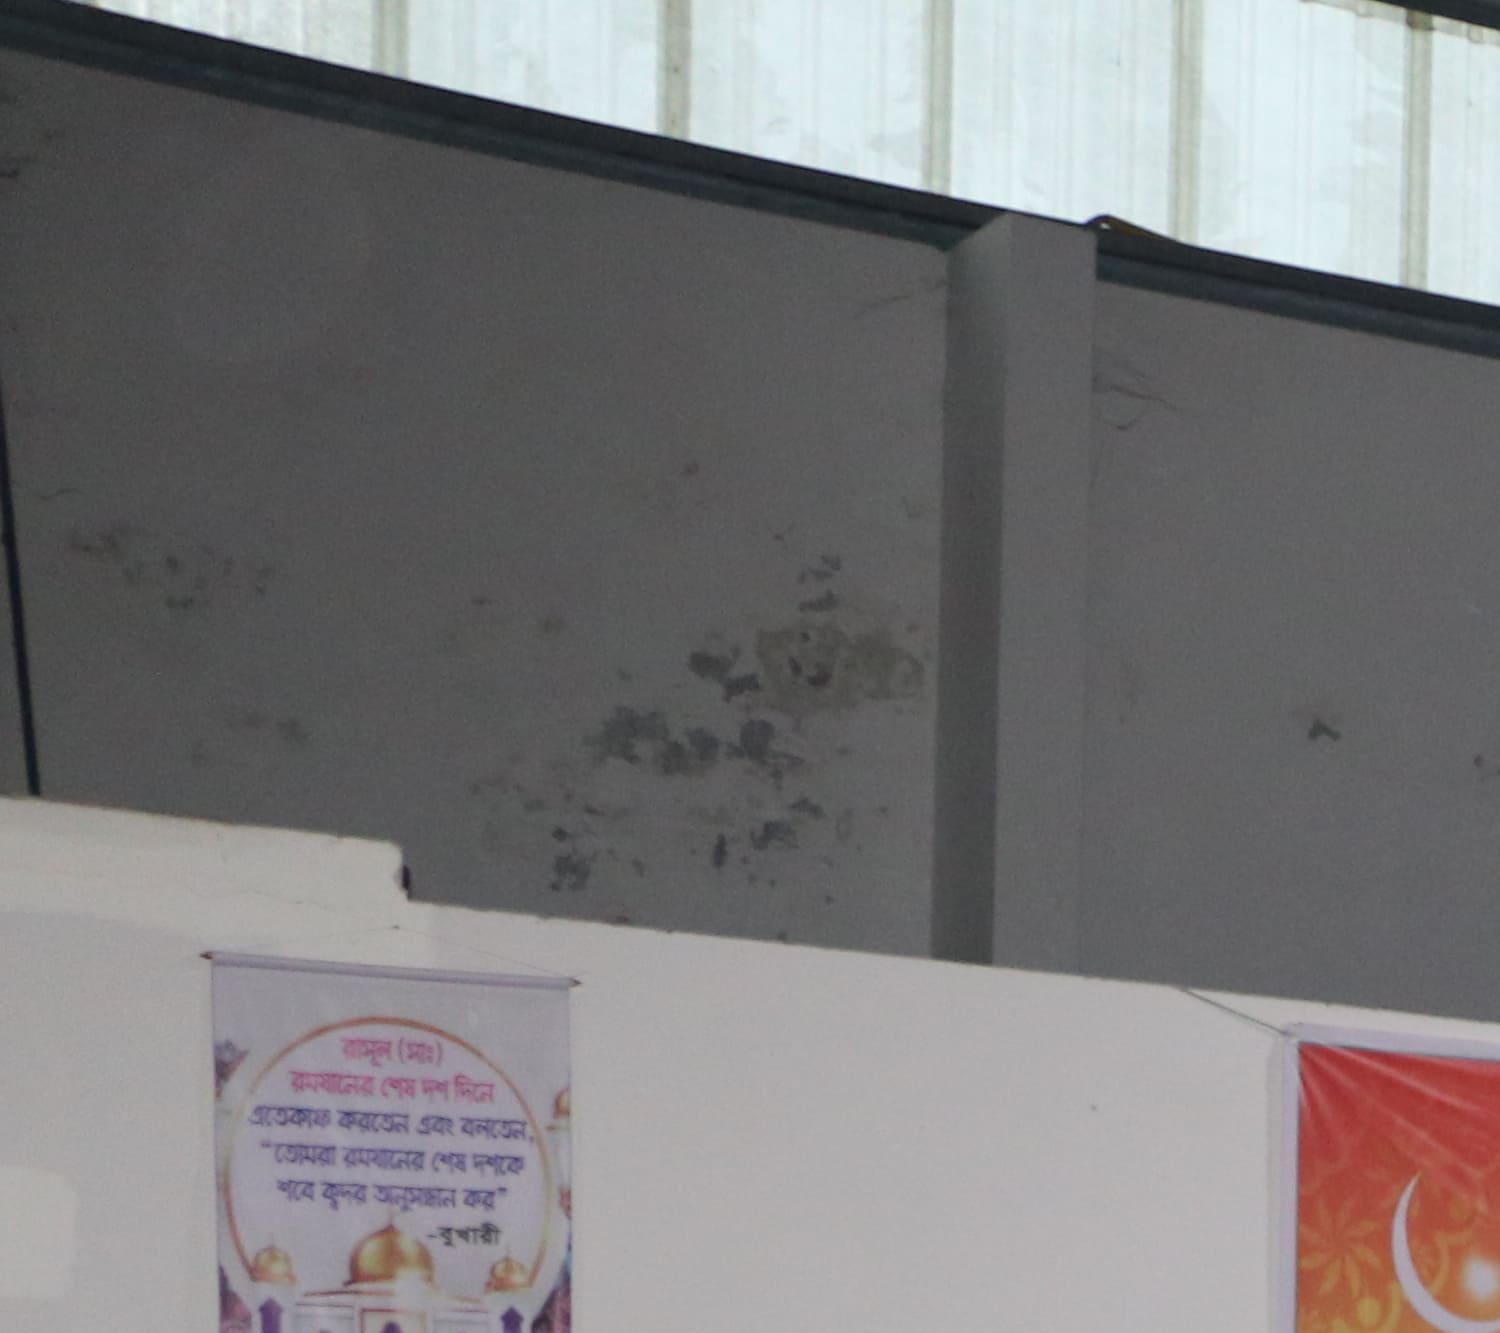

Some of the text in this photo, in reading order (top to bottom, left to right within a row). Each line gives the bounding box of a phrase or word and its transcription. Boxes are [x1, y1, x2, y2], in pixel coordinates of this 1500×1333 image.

[381, 1076, 416, 1098] শেষ
[336, 1109, 410, 1133] করতেন
[417, 1115, 453, 1137] এবং
[432, 1151, 466, 1172] শেষ
